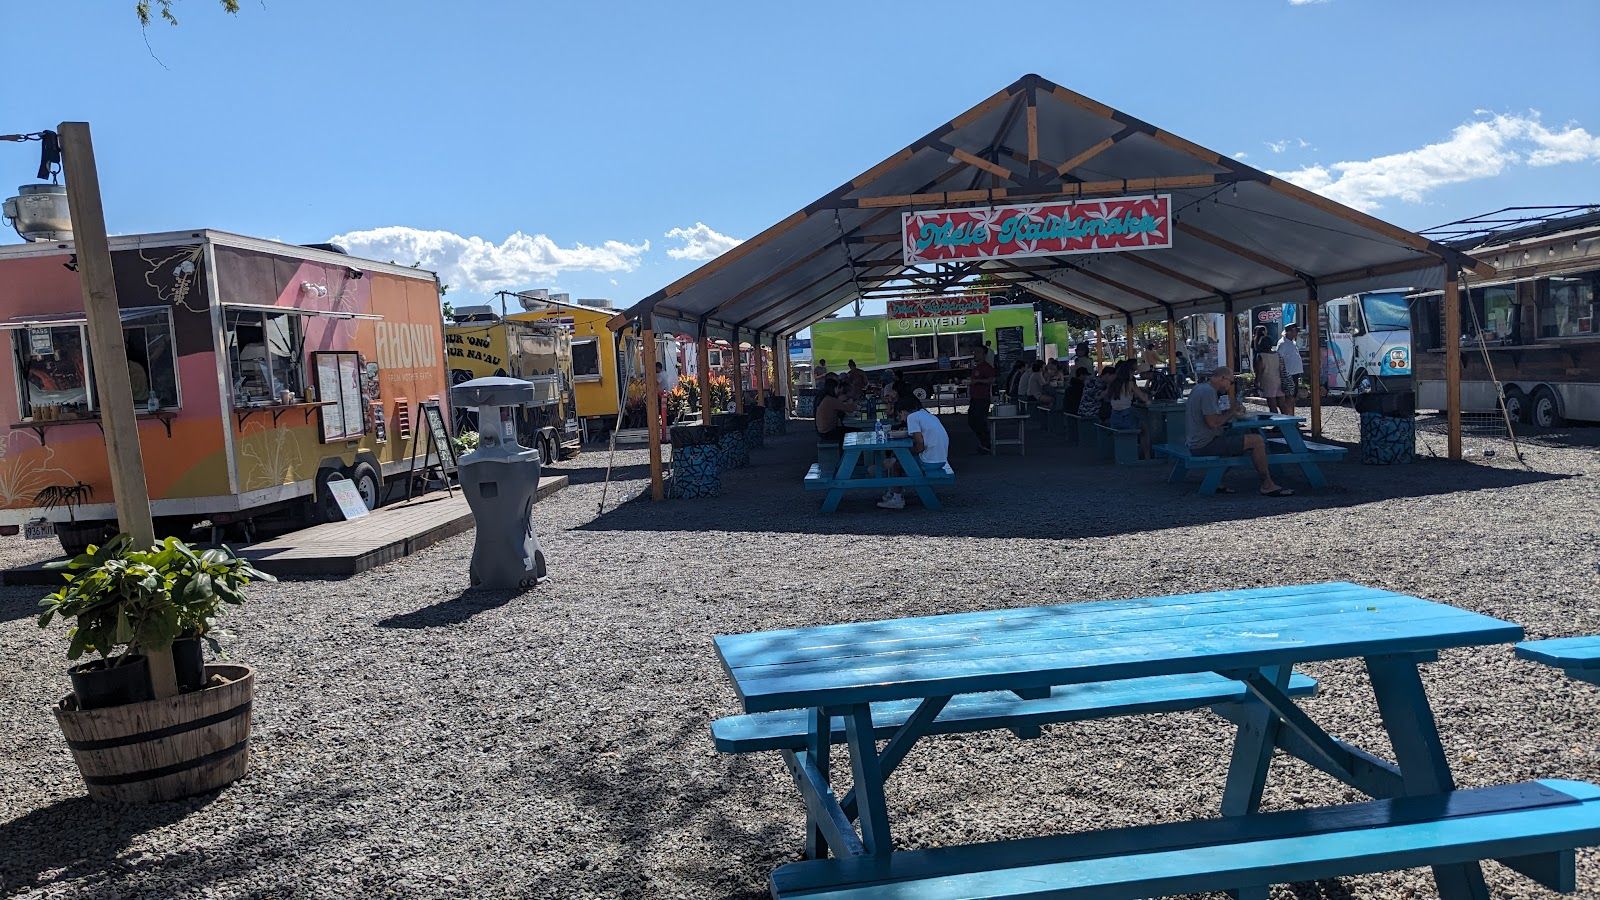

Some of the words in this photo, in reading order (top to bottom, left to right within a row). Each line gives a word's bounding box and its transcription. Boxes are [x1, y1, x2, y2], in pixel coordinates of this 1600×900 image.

[916, 221, 987, 250] Mele
[997, 210, 1158, 244] Kalikimaka
[913, 316, 967, 328] HAVENS
[376, 321, 437, 369] AHONUI
